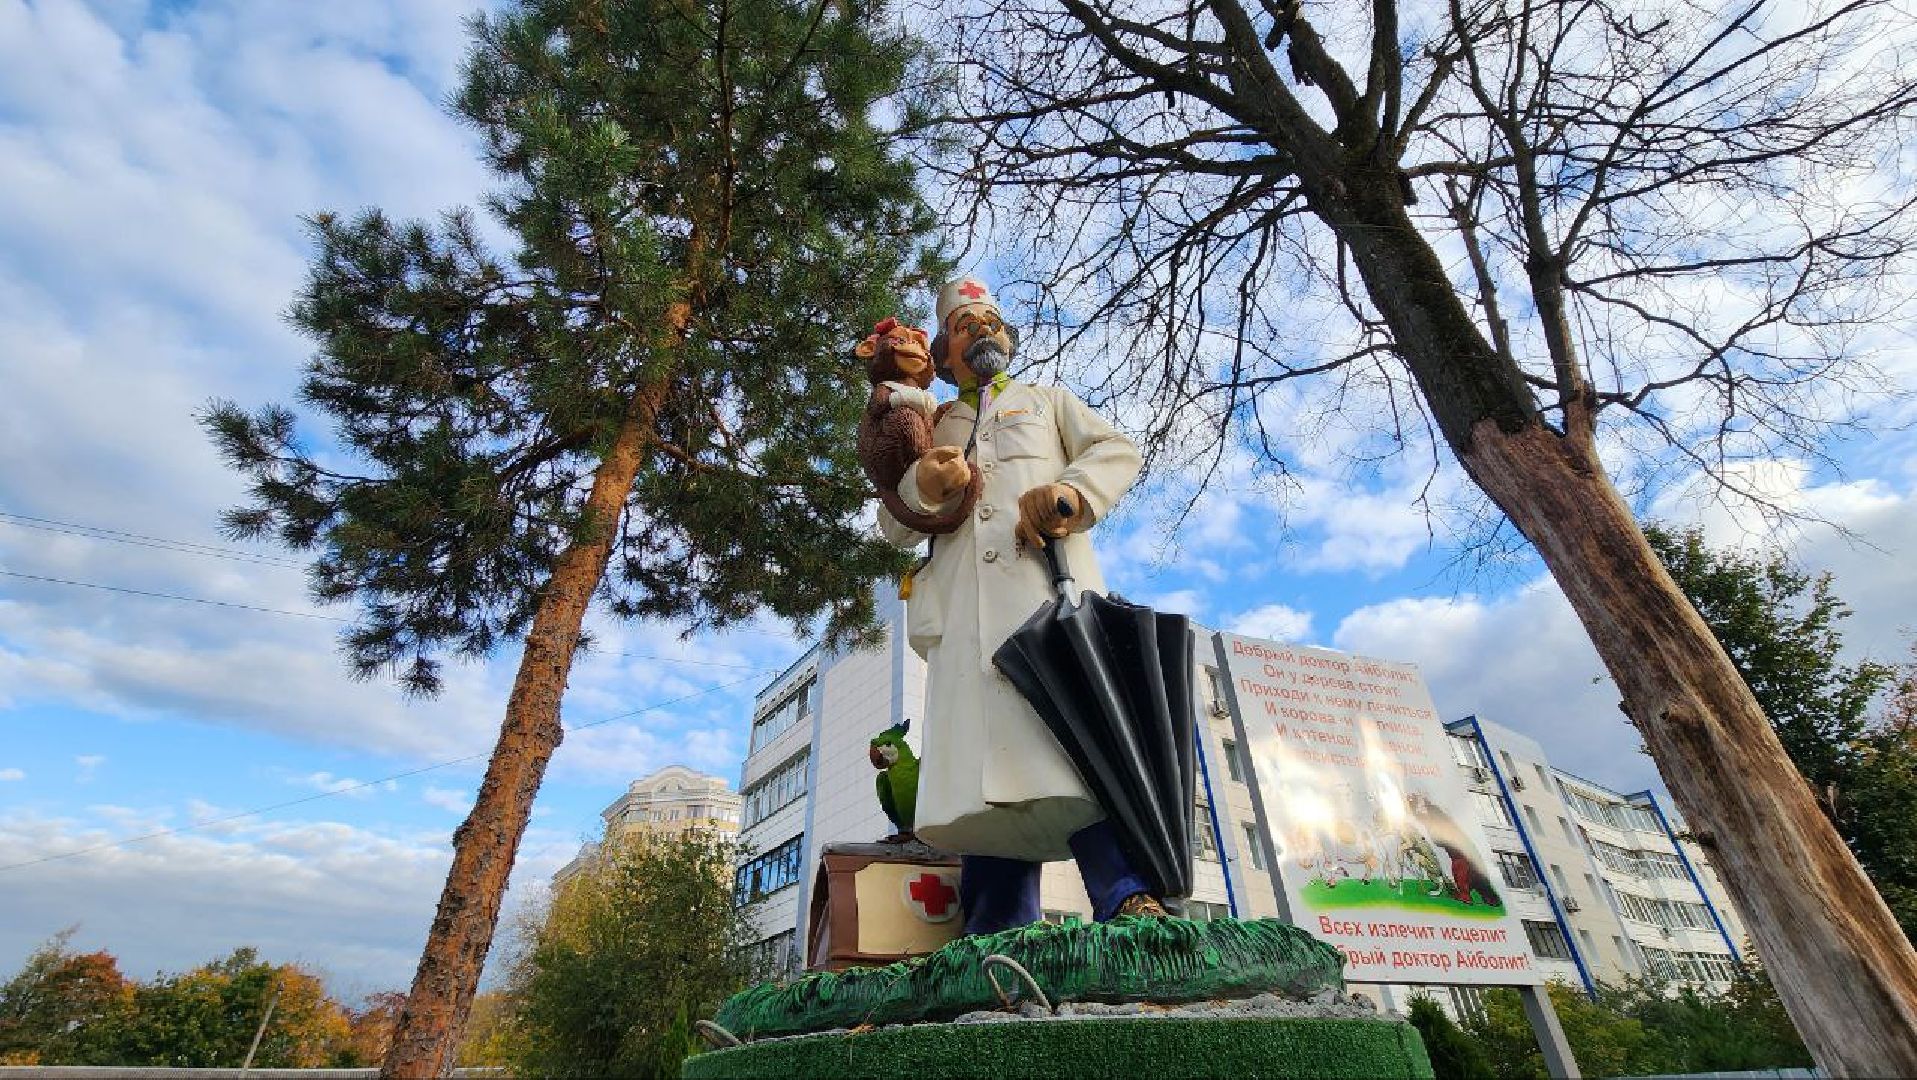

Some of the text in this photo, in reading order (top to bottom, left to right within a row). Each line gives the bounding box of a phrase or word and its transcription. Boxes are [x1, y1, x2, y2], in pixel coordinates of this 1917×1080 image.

[1233, 640, 1295, 662] Добрый
[1300, 656, 1350, 676] доктор
[1263, 664, 1285, 678] Он
[1290, 672, 1297, 684] у
[1303, 674, 1356, 691] дерева
[1241, 679, 1309, 701] Приходи
[1326, 696, 1362, 713] нему
[1367, 701, 1433, 720] лечиться
[1265, 701, 1277, 717] И
[1276, 721, 1287, 737] И
[1319, 915, 1507, 945] Всех излечит исцелит
[1392, 950, 1451, 973] доктор
[1456, 949, 1533, 971] Айболит!
